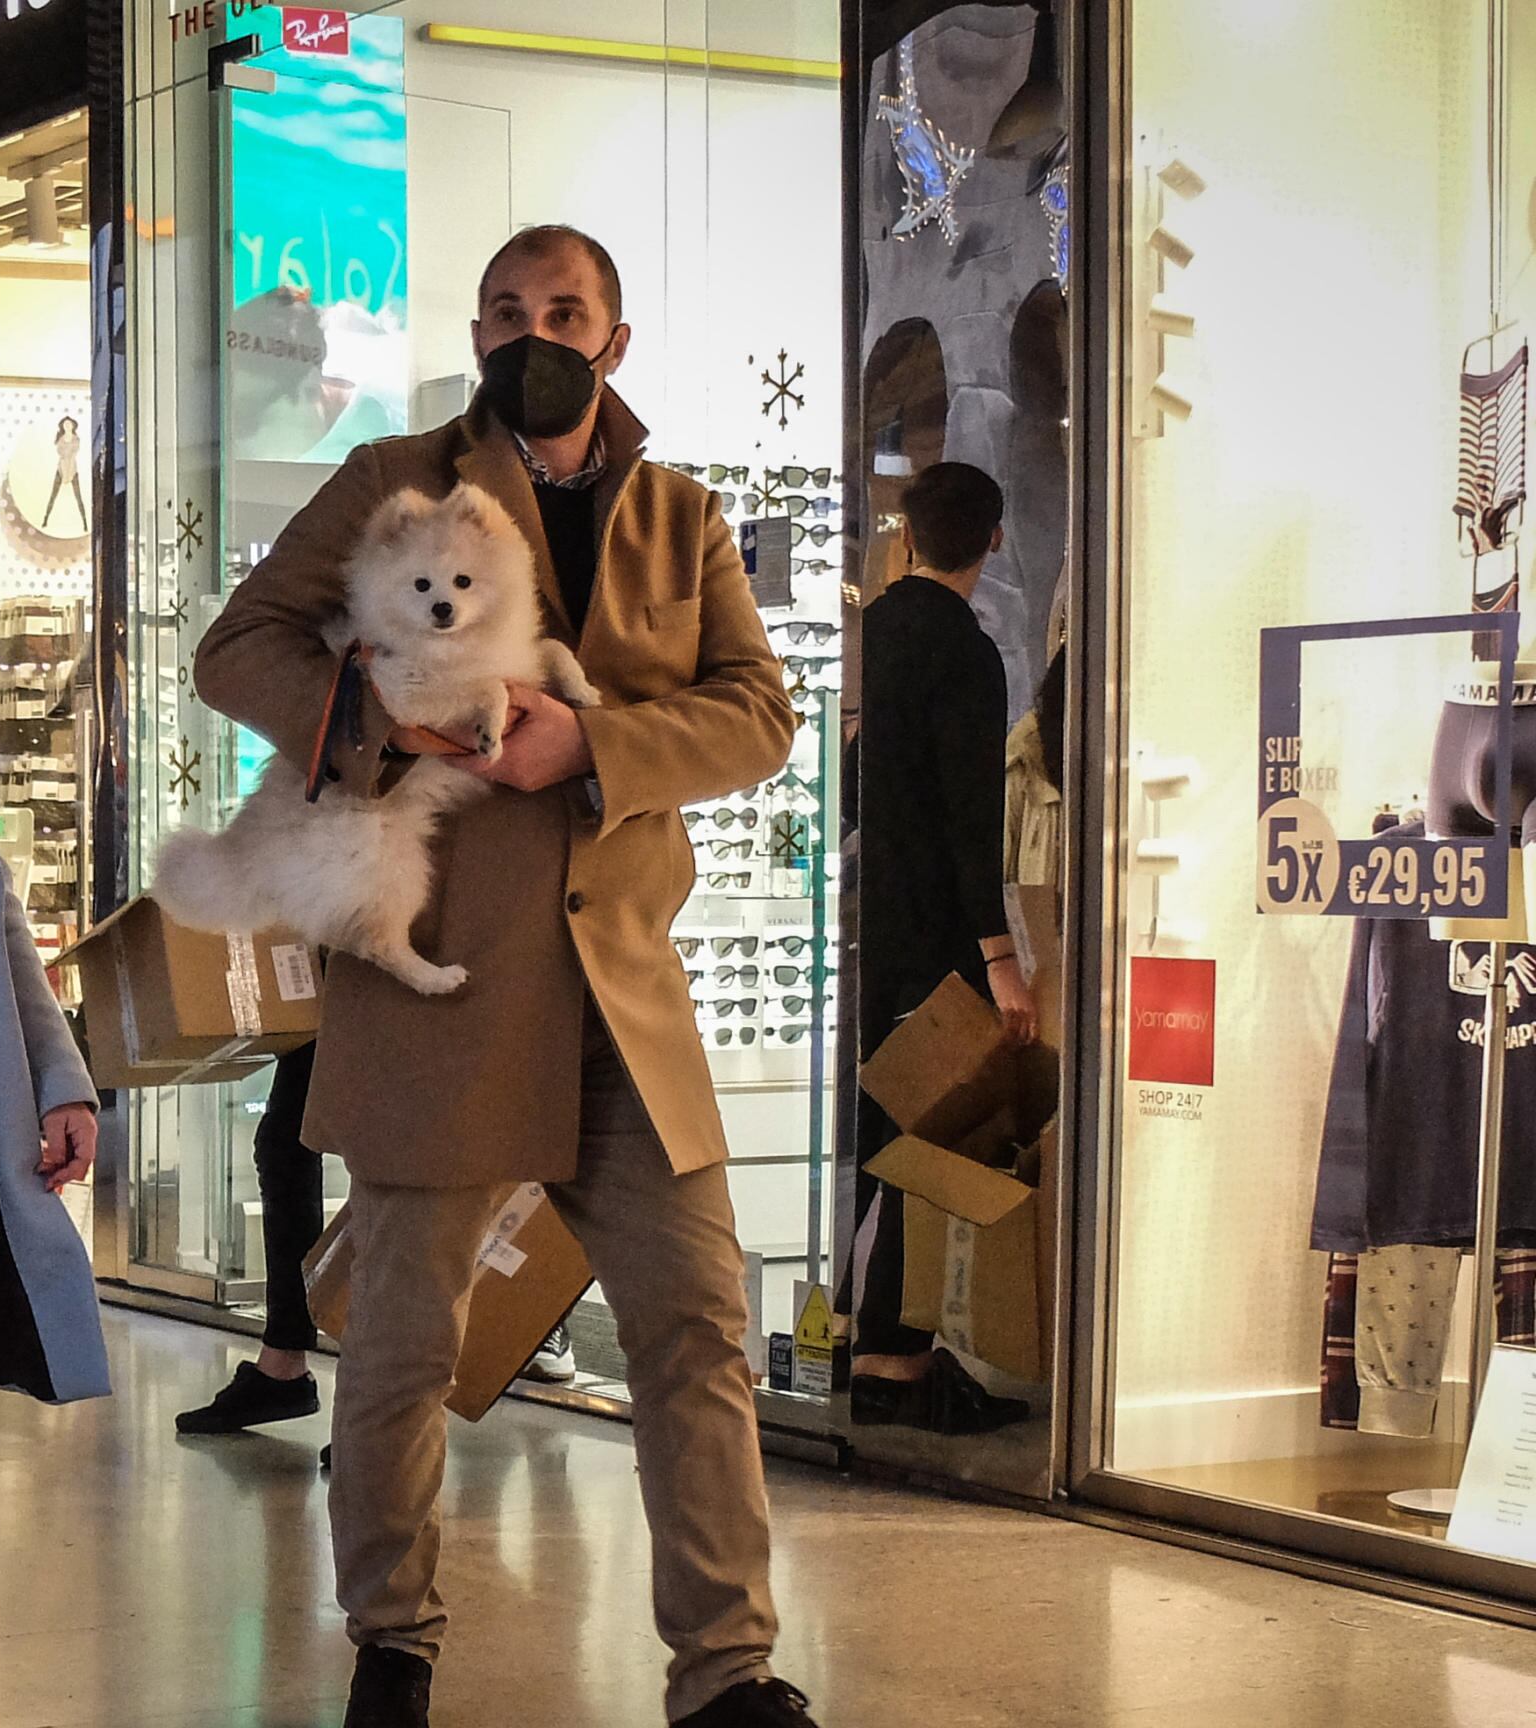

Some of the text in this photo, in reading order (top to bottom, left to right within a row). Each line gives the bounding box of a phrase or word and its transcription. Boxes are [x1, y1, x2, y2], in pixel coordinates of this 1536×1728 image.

[168, 1, 216, 42] THE
[1265, 736, 1303, 763] SLIP
[1265, 767, 1338, 793] E BOXER
[1138, 1089, 1174, 1105] SHOP
